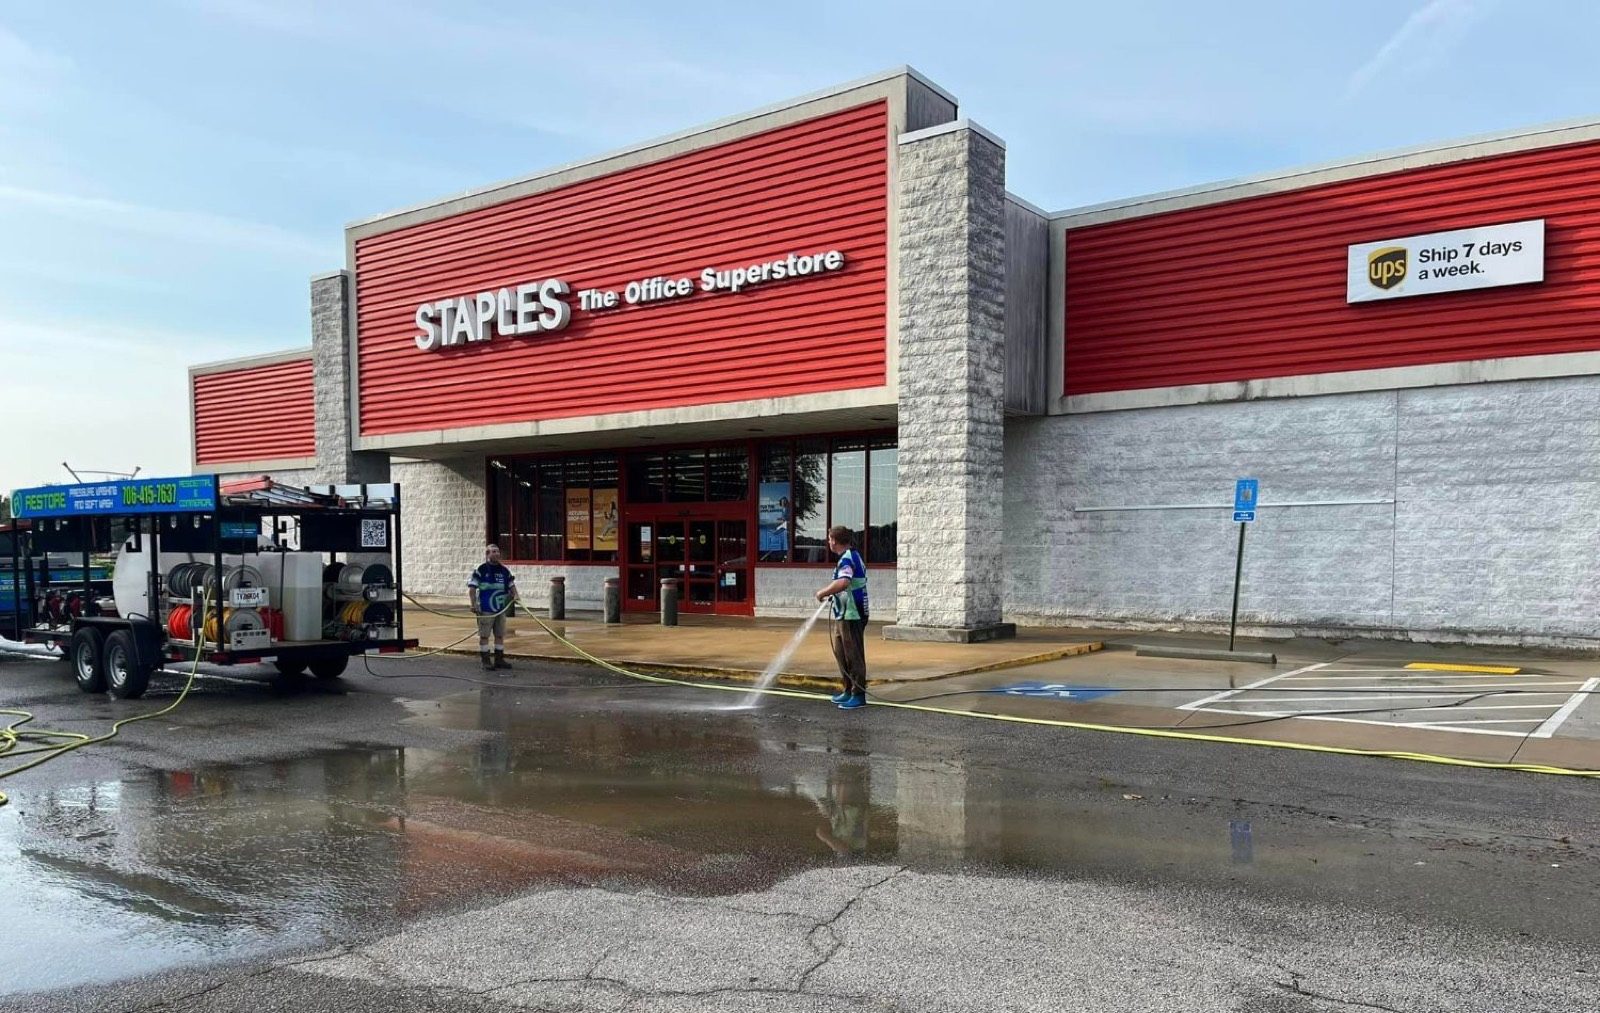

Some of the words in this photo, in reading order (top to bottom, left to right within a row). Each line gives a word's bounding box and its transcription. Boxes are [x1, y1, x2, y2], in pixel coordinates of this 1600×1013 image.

[1418, 246, 1458, 264] Ship
[1462, 243, 1475, 258] 7
[1479, 240, 1522, 257] days
[1370, 258, 1405, 285] ups
[1418, 268, 1429, 280] a
[1433, 261, 1485, 279] week.
[414, 278, 571, 350] STAPLES
[578, 288, 619, 311] The
[625, 276, 693, 305] Office
[700, 249, 846, 291] Superstore
[25, 492, 67, 511] RESTORE
[123, 483, 177, 505] 706-415-7637
